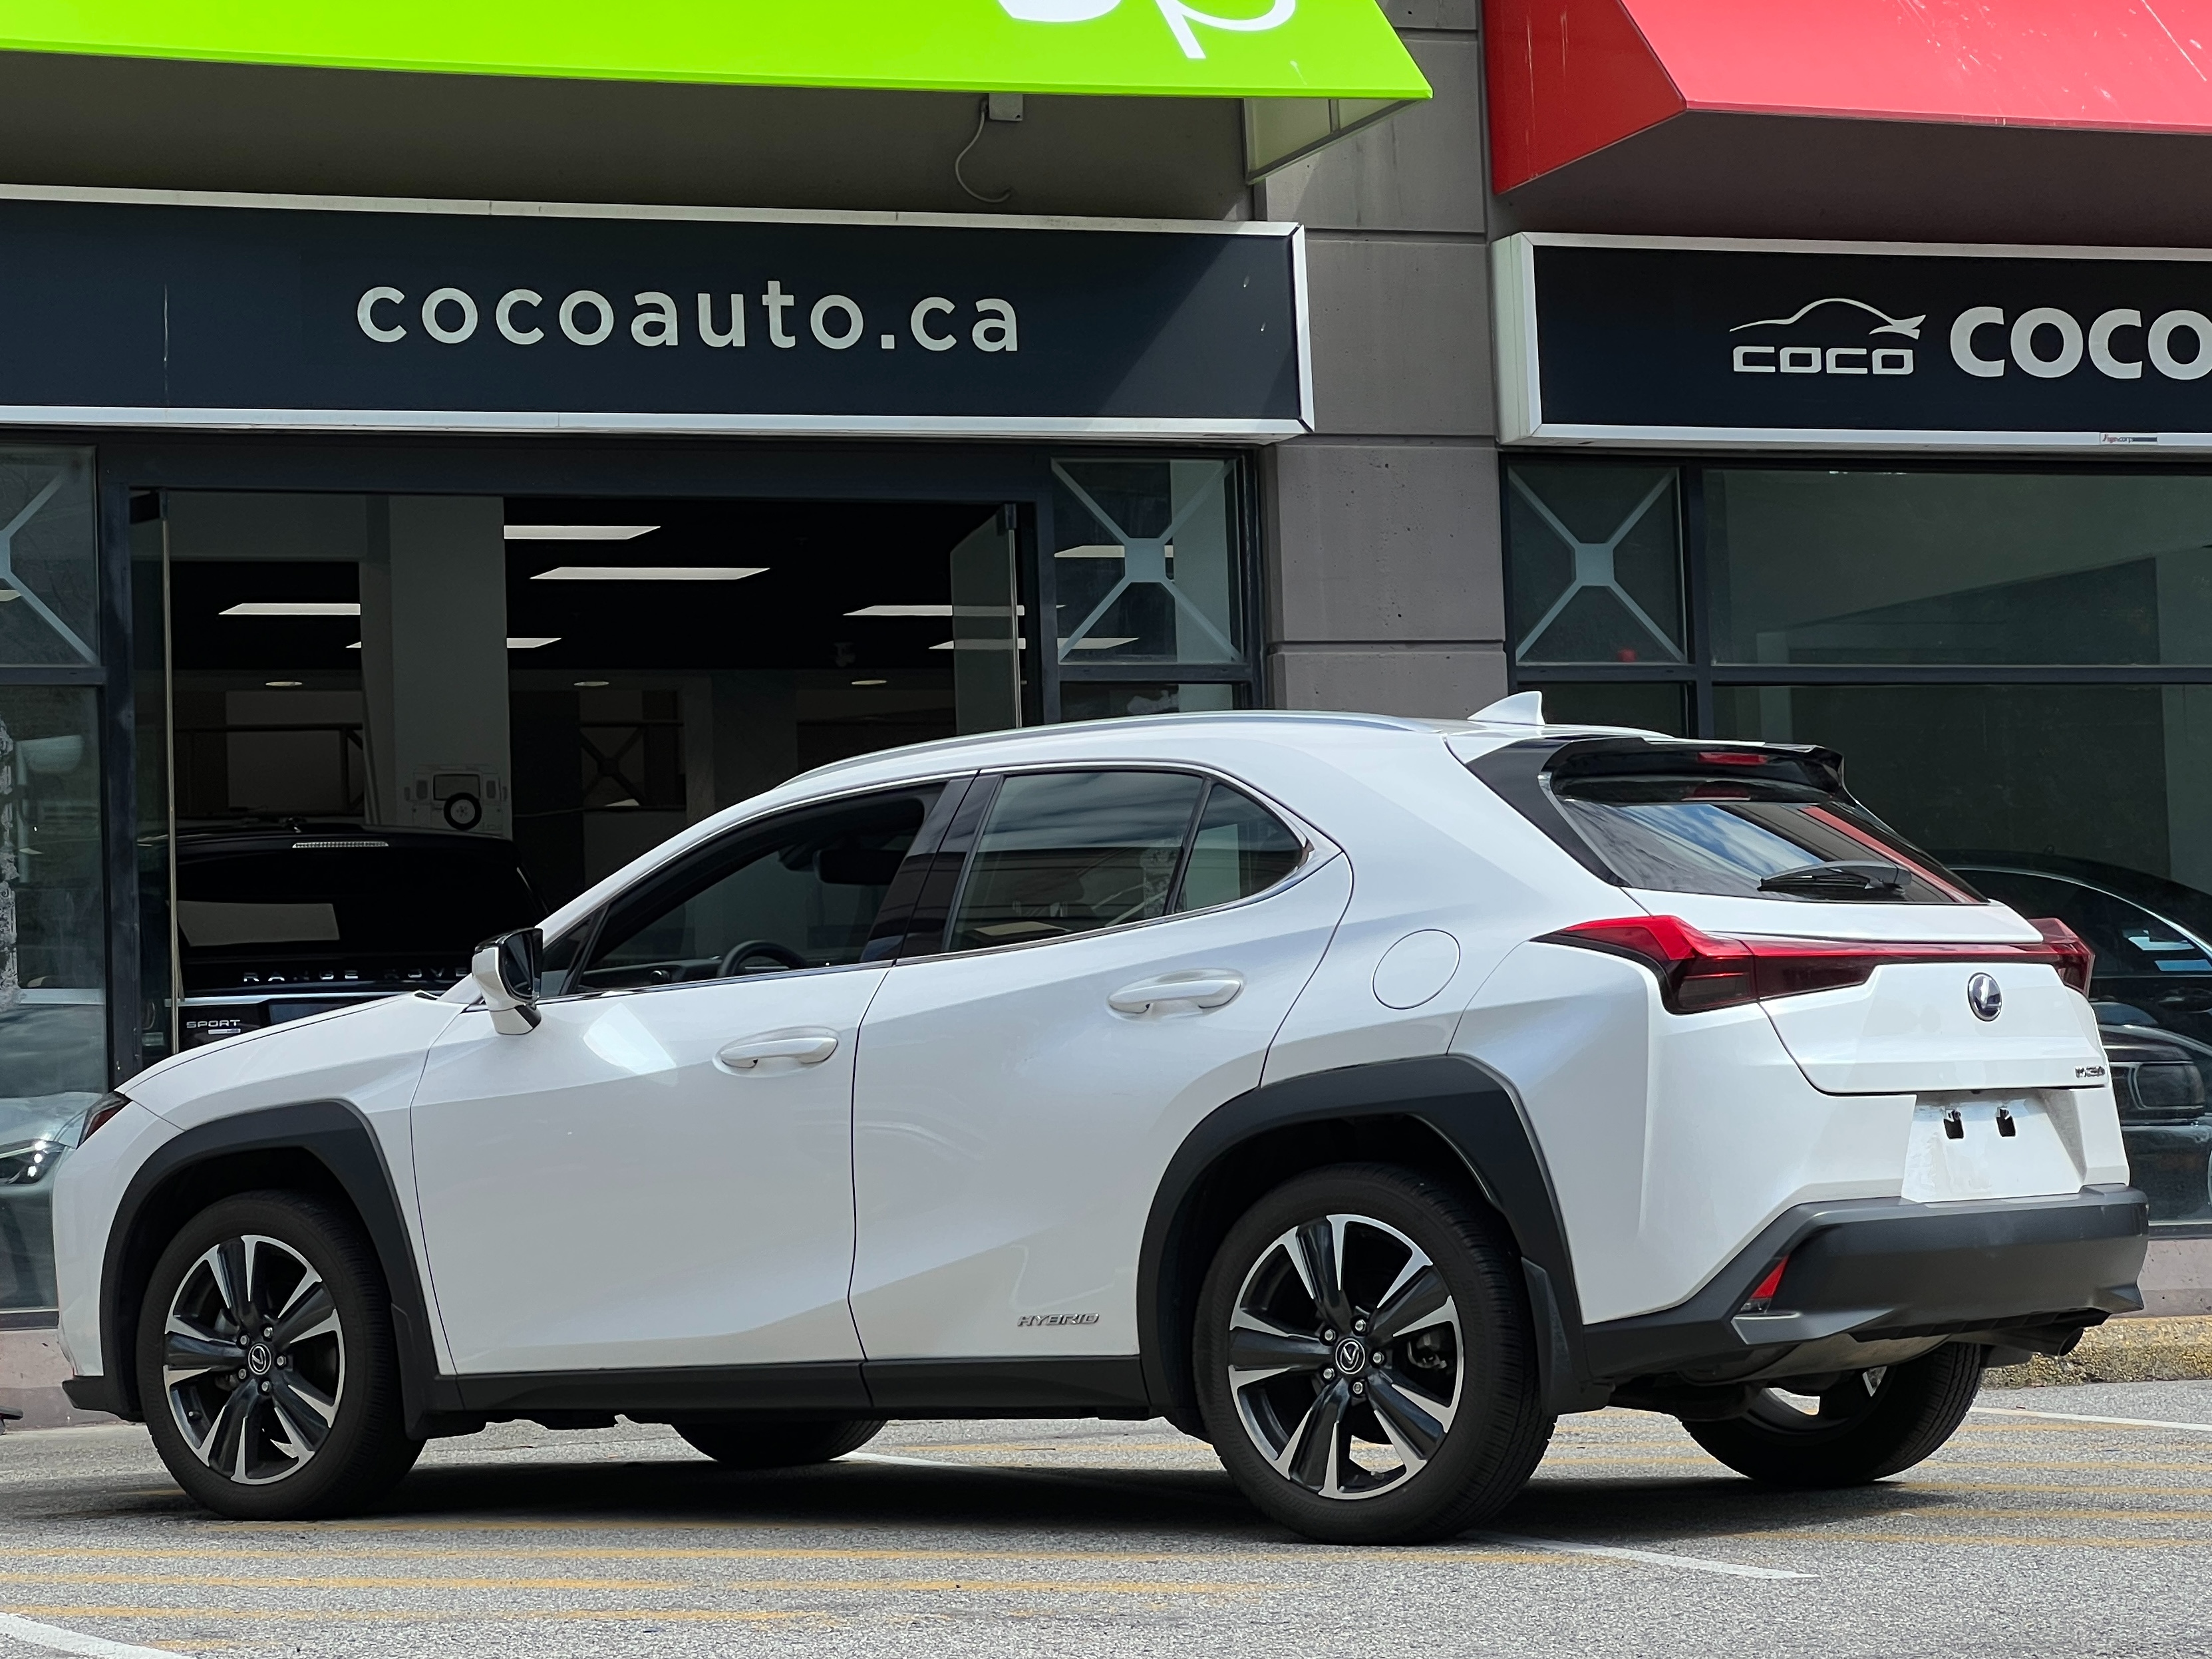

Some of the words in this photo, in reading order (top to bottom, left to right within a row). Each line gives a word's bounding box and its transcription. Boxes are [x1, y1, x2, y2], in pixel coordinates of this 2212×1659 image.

[357, 280, 1018, 352] cocoauto.ca
[1950, 306, 2212, 380] COCO
[1732, 346, 1914, 375] COCO
[385, 967, 468, 979] ROVE
[186, 1019, 241, 1028] SPORT
[1017, 1313, 1100, 1327] HYBRID
